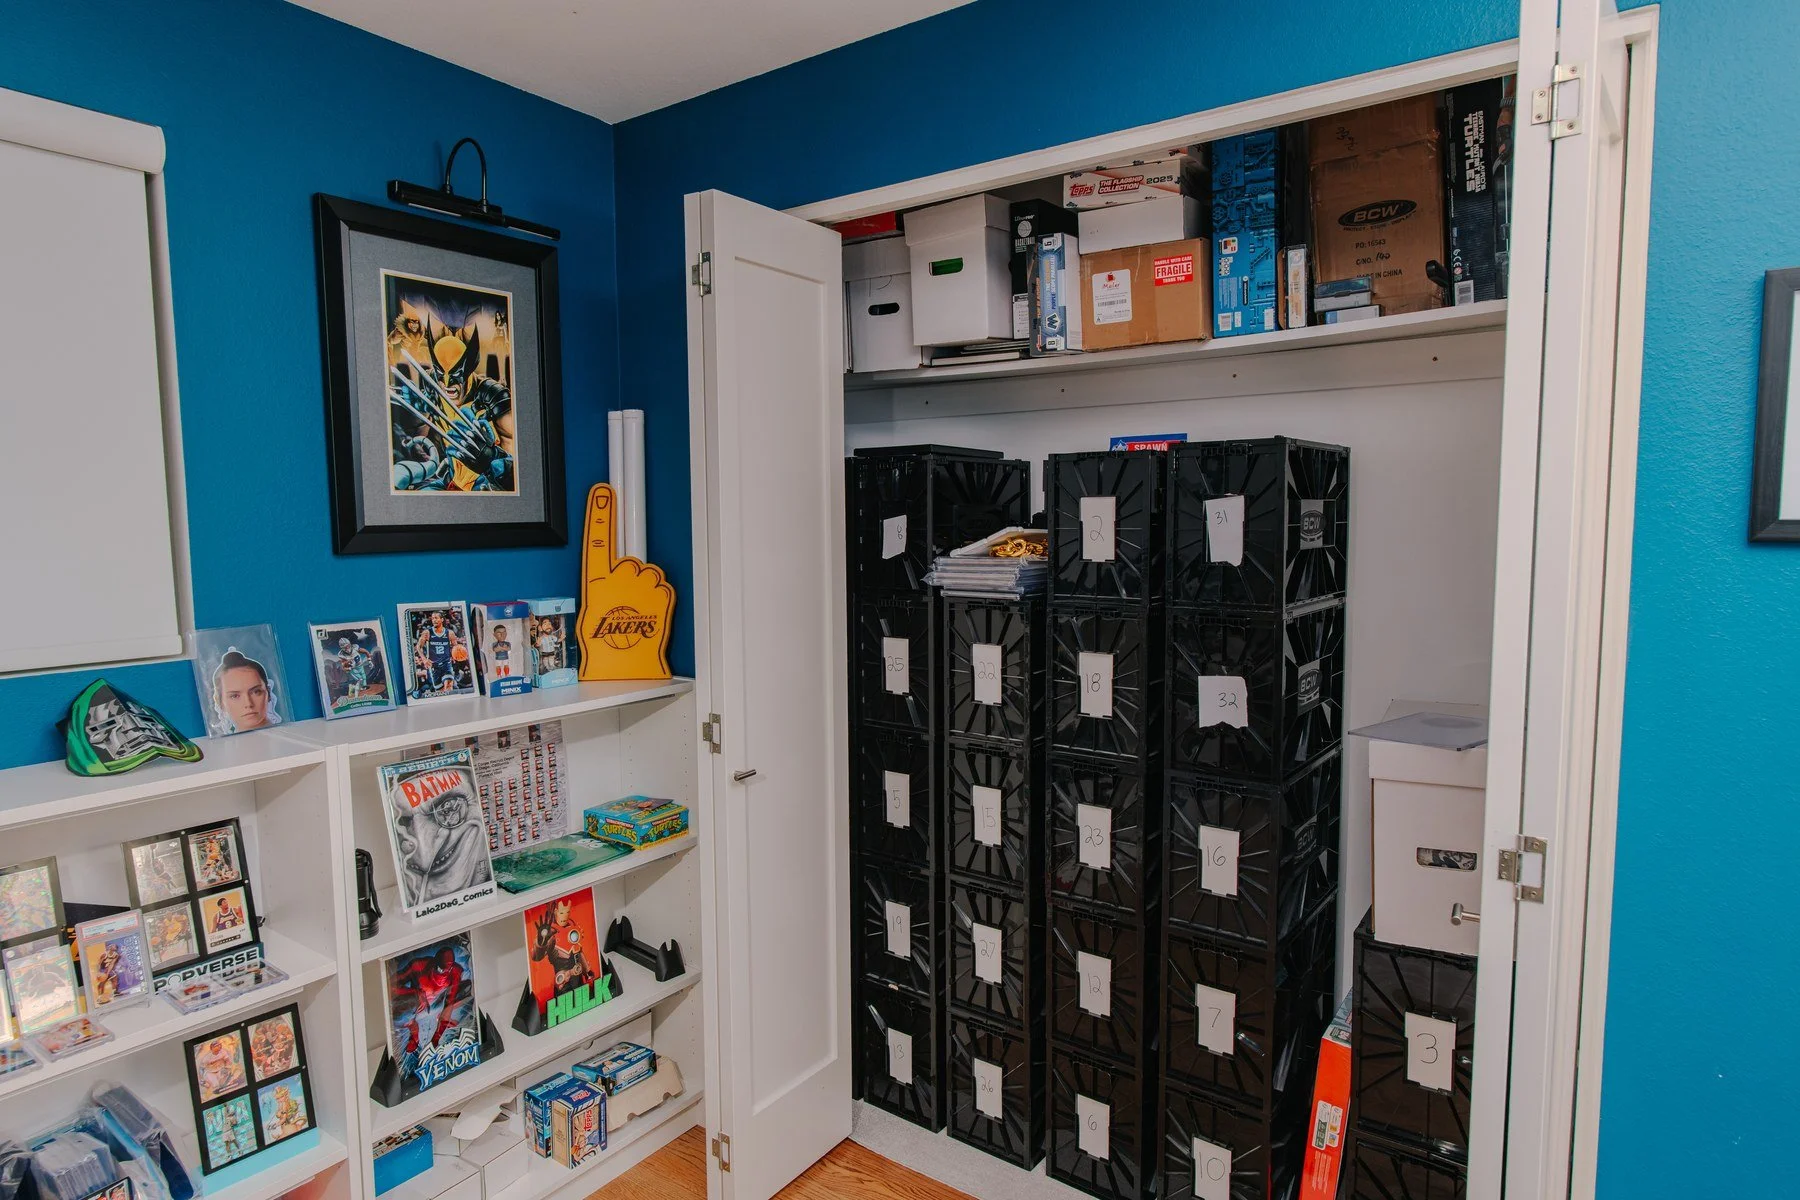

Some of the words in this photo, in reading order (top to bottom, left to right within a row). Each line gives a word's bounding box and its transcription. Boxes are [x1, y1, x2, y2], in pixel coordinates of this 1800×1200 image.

[1464, 113, 1475, 192] TURTLES
[1099, 182, 1139, 193] COLLECTION
[1113, 176, 1143, 184] FLAGSHIP
[1146, 174, 1173, 184] 2025
[1354, 204, 1399, 222] BCW
[1156, 263, 1191, 277] FRAGILE
[1383, 269, 1402, 277] CHINA
[1134, 443, 1168, 452] SPAWN
[1215, 510, 1227, 525] 31
[1303, 517, 1320, 530] BCW
[1090, 515, 1105, 541] 2
[590, 617, 660, 638] LAKERS
[435, 646, 444, 654] 12
[887, 656, 904, 672] 25
[978, 660, 997, 680] 22
[501, 687, 521, 695] MINIX
[1086, 672, 1101, 693] 18
[1300, 675, 1317, 692] BCW
[1218, 693, 1238, 708] 32
[399, 757, 456, 772] REBIRTH
[401, 770, 462, 808] BATMAN
[894, 790, 900, 809] 5
[982, 807, 996, 828] 15
[602, 824, 638, 842] TURTLES
[649, 819, 682, 837] TURTLES
[1085, 825, 1104, 847] 23
[1207, 845, 1226, 867] 16
[892, 915, 902, 934] 19
[980, 940, 996, 959] 27
[1087, 972, 1103, 995] 12
[547, 973, 613, 1028] HULK
[1208, 1007, 1221, 1027] 7
[1416, 1032, 1439, 1064] 3
[420, 1046, 479, 1086] VENOM
[980, 1076, 994, 1093] 26
[1087, 1114, 1097, 1131] 6
[1199, 1152, 1225, 1181] 10
